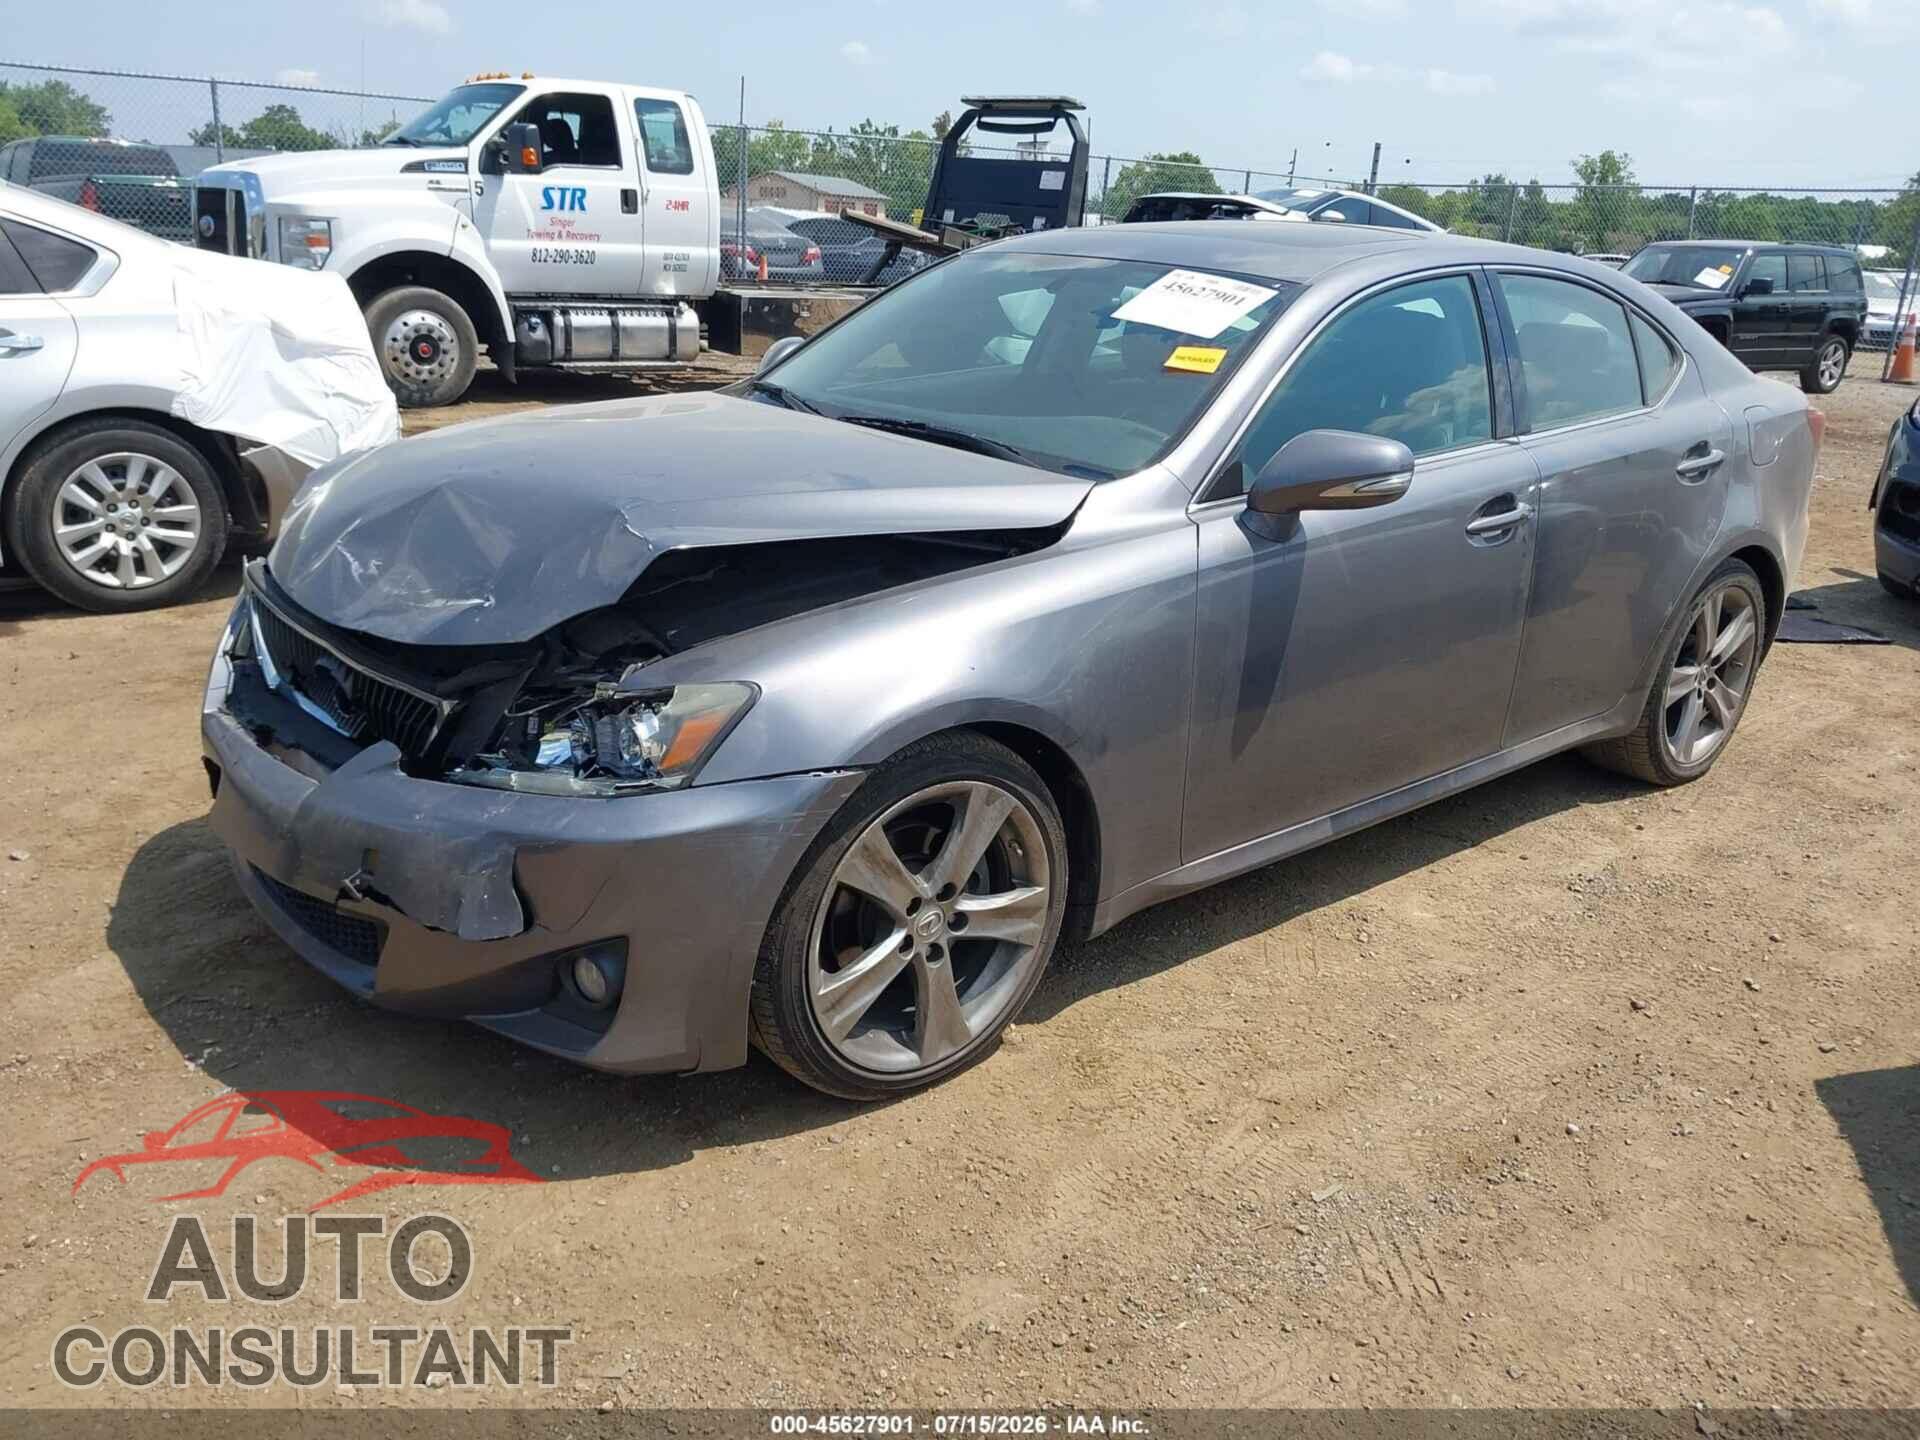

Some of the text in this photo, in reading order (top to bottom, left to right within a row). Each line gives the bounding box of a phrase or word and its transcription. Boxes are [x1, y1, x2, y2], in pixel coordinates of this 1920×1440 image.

[474, 181, 484, 196] 5
[541, 187, 587, 211] STR
[550, 217, 576, 229] Singer
[527, 229, 601, 243] Towing & Recovery
[531, 248, 596, 264] 812-290-3620
[1163, 281, 1247, 306] 45627901
